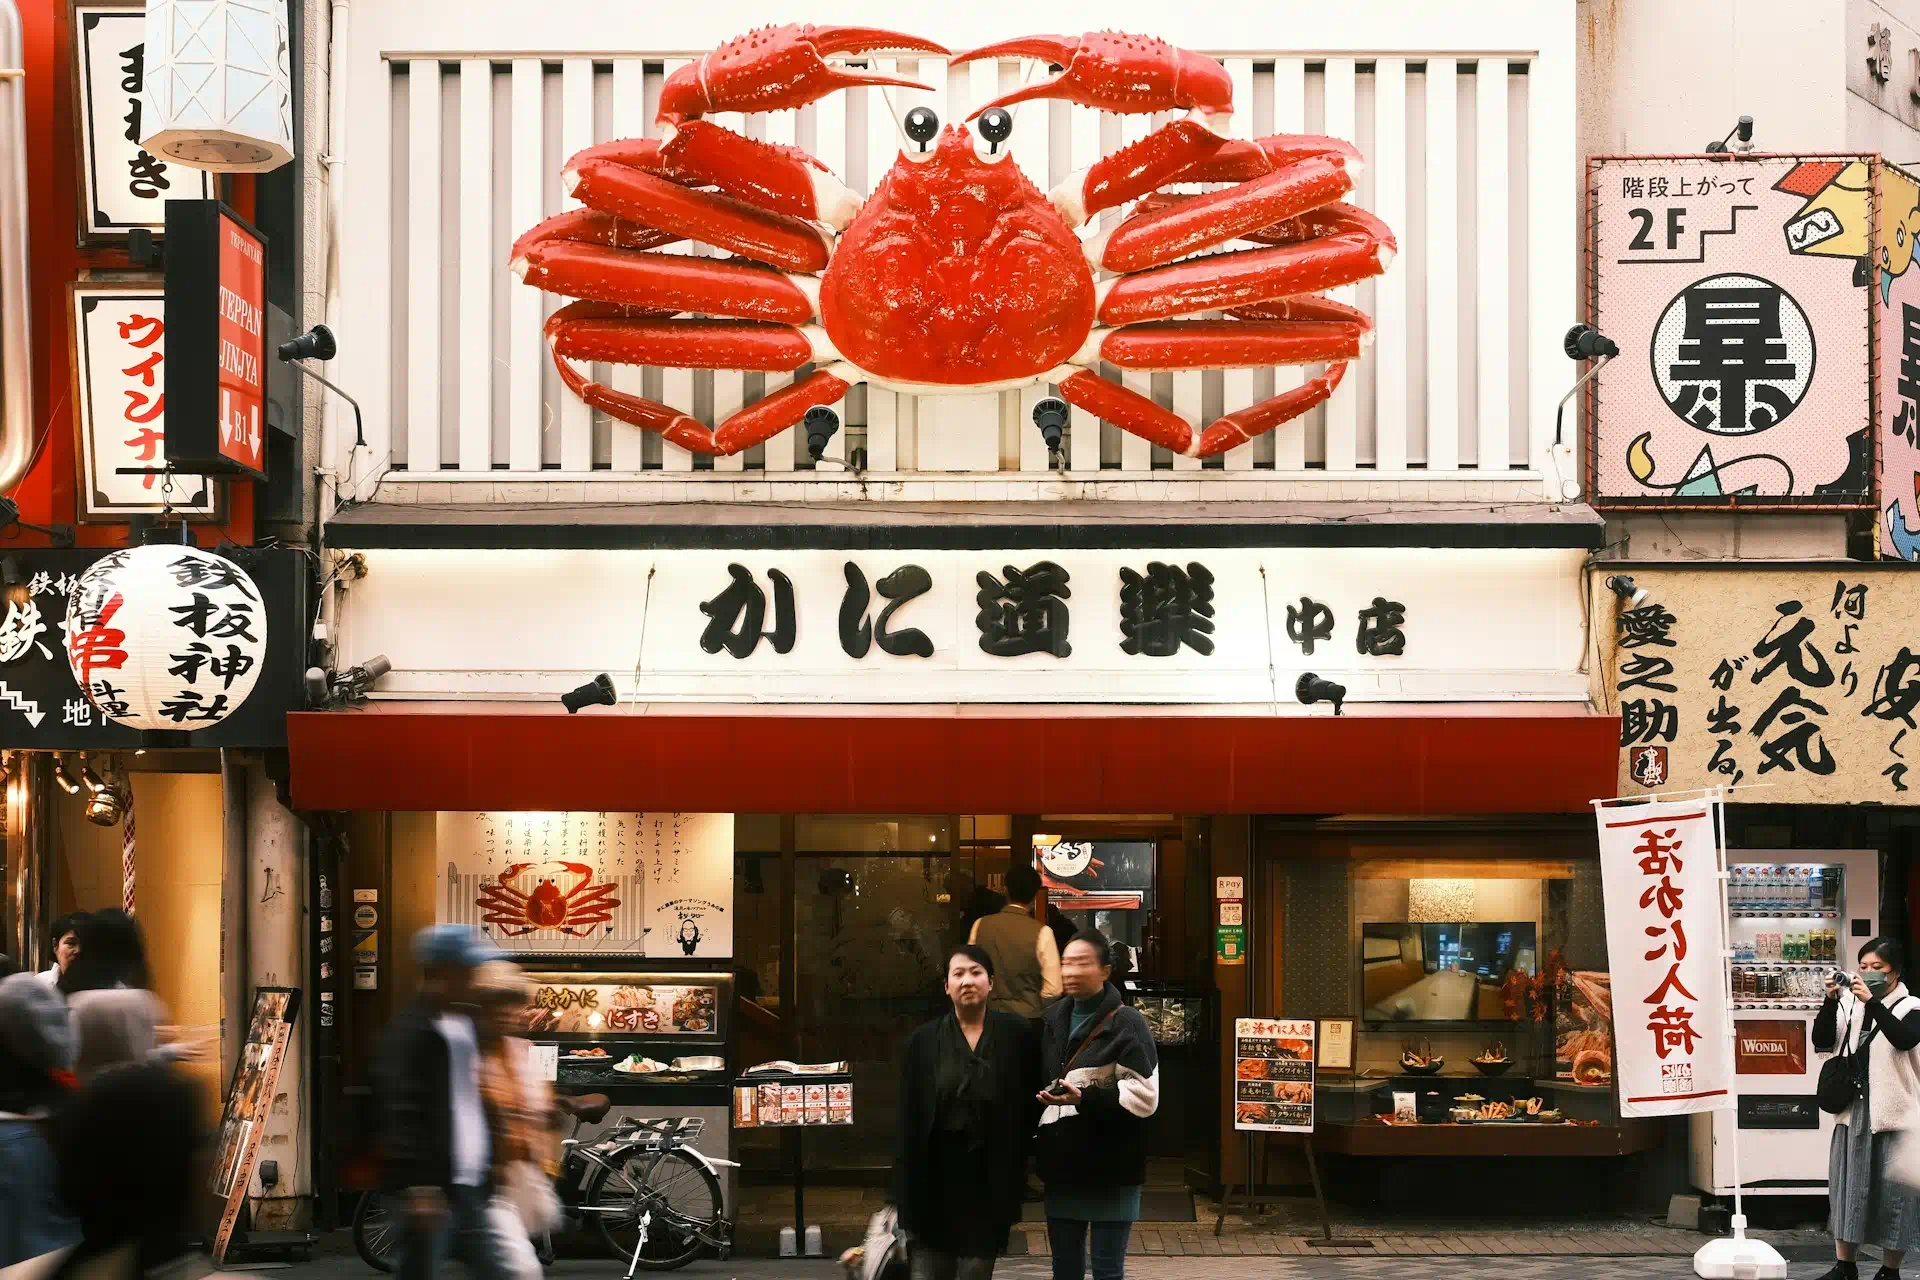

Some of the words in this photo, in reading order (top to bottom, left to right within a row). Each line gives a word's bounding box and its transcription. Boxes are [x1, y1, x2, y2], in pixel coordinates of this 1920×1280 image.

[1623, 175, 1755, 198] 階段上がって
[230, 231, 263, 266] TEPPANYAKI
[1628, 208, 1686, 250] 2F
[219, 285, 262, 338] TEPPAN
[219, 339, 258, 386] JINJYA
[234, 410, 248, 446] B1
[0, 599, 68, 662] 鉄
[158, 555, 258, 723] 鉄板神社
[1286, 596, 1406, 656] 中店
[1831, 580, 1868, 697] 何より
[1616, 604, 1678, 747] 愛之助
[1748, 600, 1836, 775] 元気
[1226, 880, 1241, 888] Pay
[536, 987, 599, 1010] 焼かに
[590, 1008, 661, 1032] にすき
